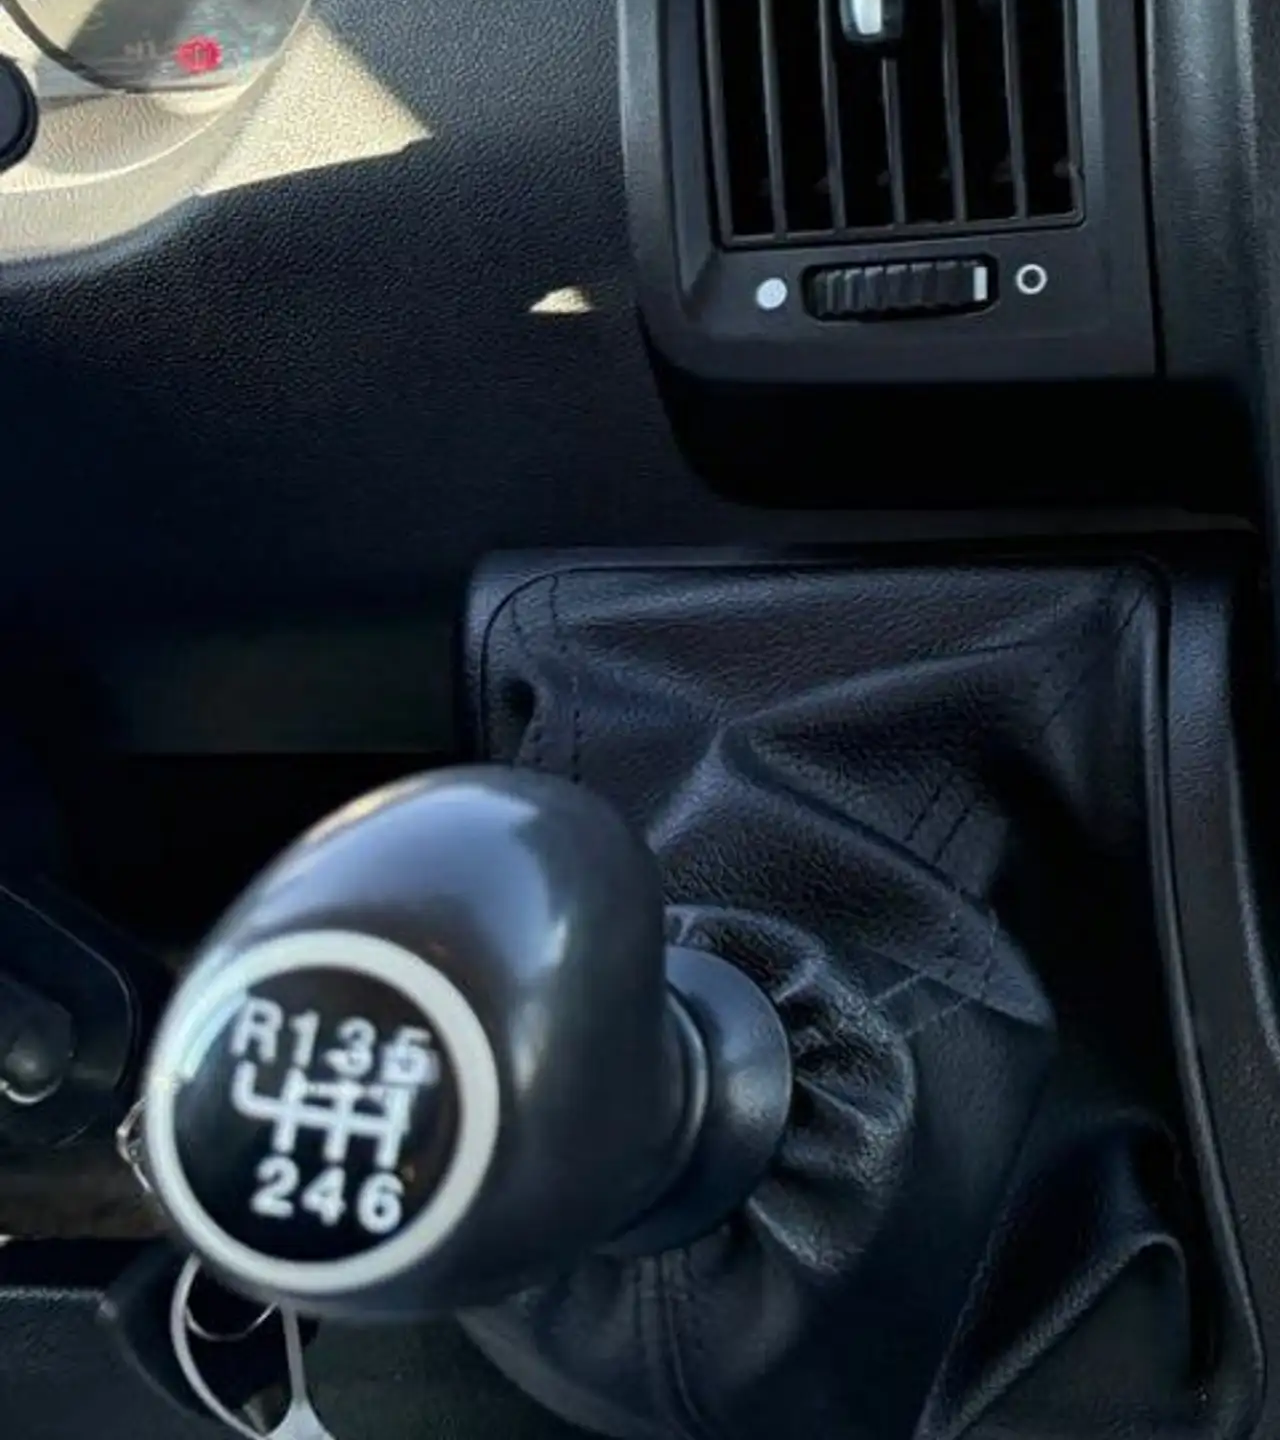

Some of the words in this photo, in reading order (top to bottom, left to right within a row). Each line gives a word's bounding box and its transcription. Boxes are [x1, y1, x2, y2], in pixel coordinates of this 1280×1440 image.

[228, 996, 284, 1065] R
[288, 1009, 321, 1069] 1
[322, 1016, 377, 1079] 3
[379, 1025, 441, 1086] 5
[250, 1155, 300, 1220] 2
[301, 1164, 347, 1227] 4
[356, 1170, 406, 1235] 6
